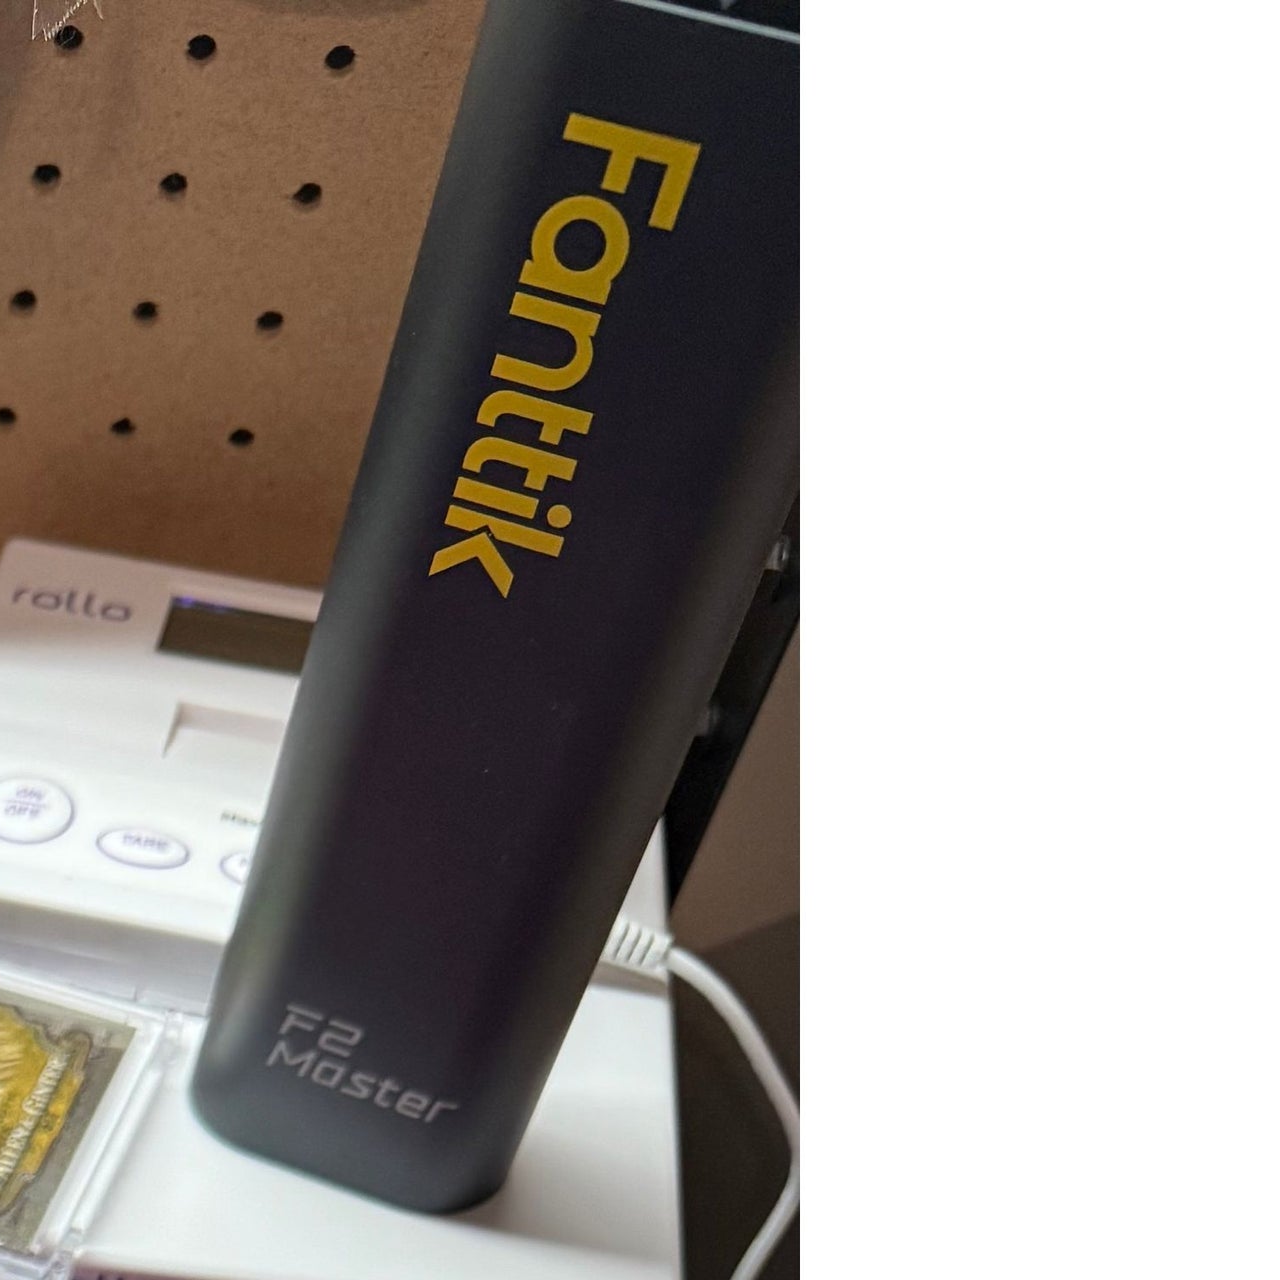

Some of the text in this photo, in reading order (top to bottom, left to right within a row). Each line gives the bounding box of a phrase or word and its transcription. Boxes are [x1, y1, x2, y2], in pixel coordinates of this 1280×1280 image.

[428, 112, 702, 600] Fanttik
[12, 587, 133, 623] rollo
[279, 1002, 366, 1059] F2
[265, 1038, 460, 1125] Master
